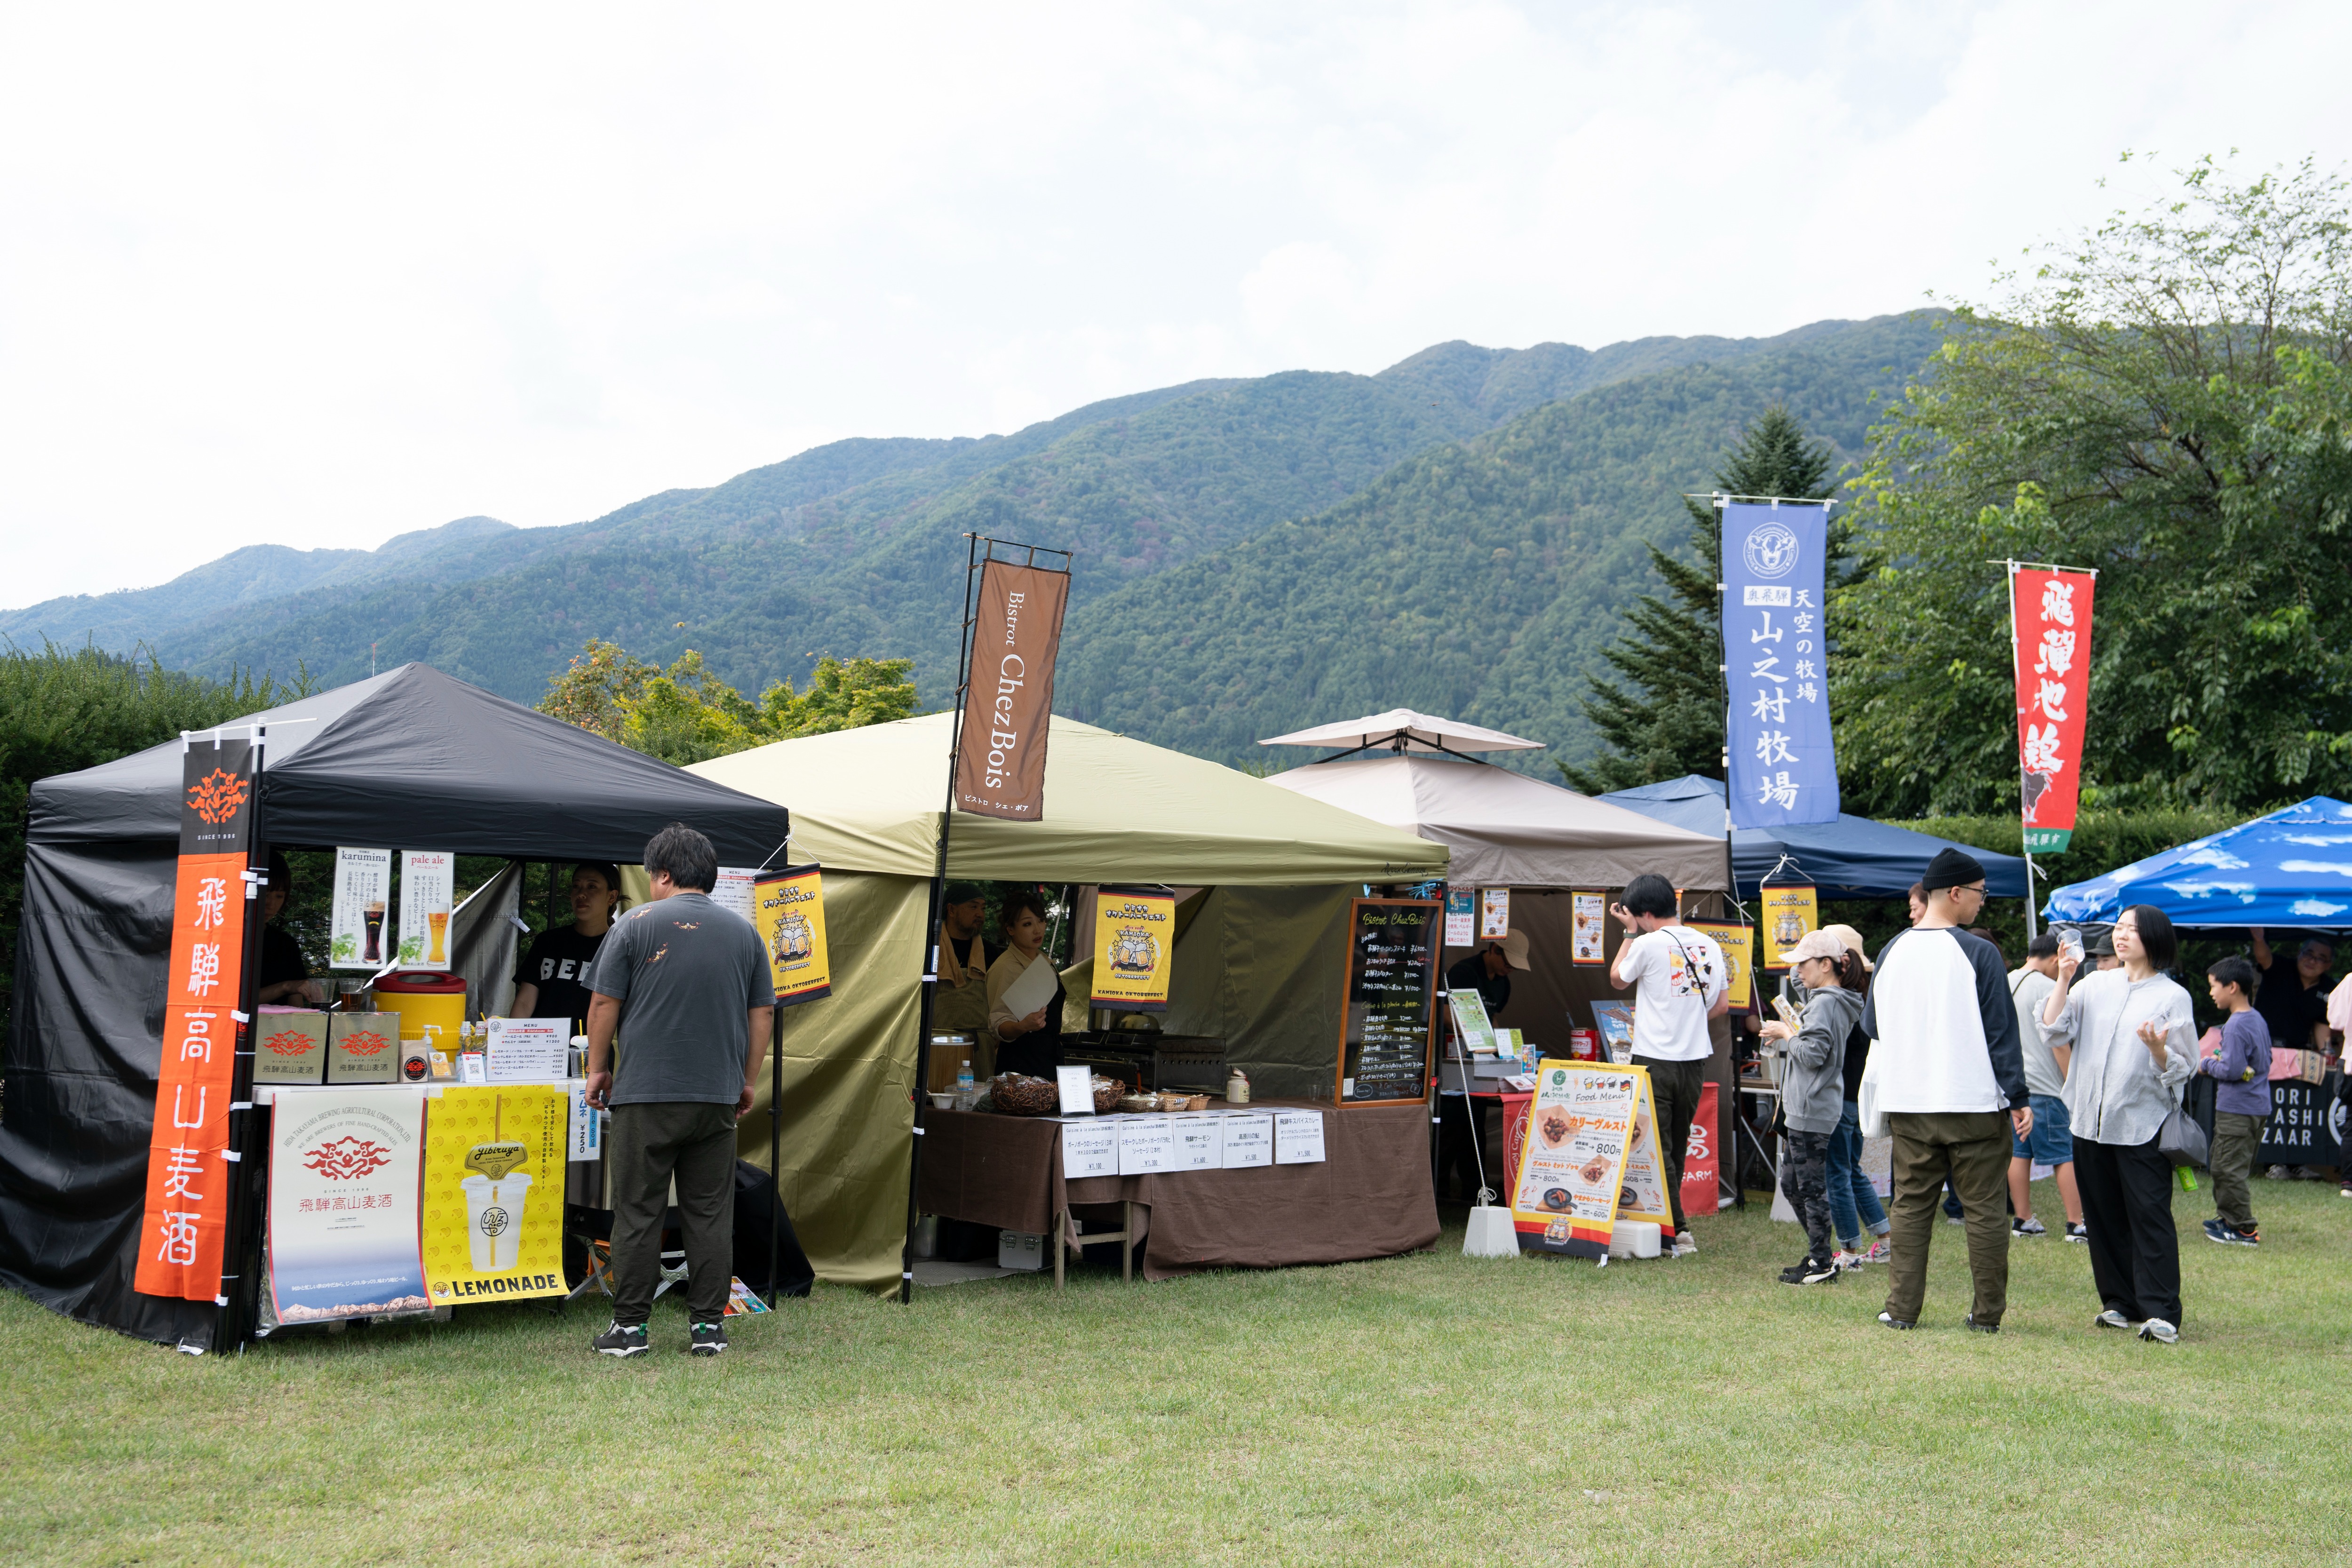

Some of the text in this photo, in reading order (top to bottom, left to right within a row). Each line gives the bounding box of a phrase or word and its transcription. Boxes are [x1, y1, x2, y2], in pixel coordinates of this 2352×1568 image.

[1794, 589, 1819, 703] 天空の牧場
[985, 590, 1025, 788] Bistrot Chez Bois
[1750, 611, 1800, 811] 山之村牧場
[965, 794, 1028, 812] ビストロ シェ・ボア
[342, 851, 386, 861] karumina
[411, 855, 444, 866] pale ale
[779, 886, 800, 897] カミオカ
[763, 891, 815, 908] オクトーバーフェスト
[1124, 903, 1148, 912] カミオカ
[778, 916, 804, 925] KAMIOKA
[1105, 910, 1167, 921] オクトーバーフェスト
[1363, 913, 1387, 925] Bistrot
[1391, 913, 1408, 925] Chez
[540, 958, 592, 981] BEE
[779, 962, 810, 972] OKTOBERFEST
[792, 977, 825, 988] OKTOBERFEST
[262, 1065, 314, 1074] 飛騨高山麦酒
[1576, 1093, 1597, 1101] Food
[1600, 1092, 1626, 1101] Menu
[2275, 1088, 2311, 1106] ORI
[1570, 1116, 1627, 1132] カリーヴルスト
[2274, 1108, 2323, 1126] ASHI
[283, 1135, 295, 1148] HIDA
[293, 1116, 318, 1137] TAKAYAMA
[318, 1108, 341, 1121] BREWING
[342, 1106, 376, 1117] AGRICULTURAL
[305, 1134, 315, 1143] ARE
[315, 1123, 336, 1137] BREWERS
[358, 1121, 389, 1138] HAND-CRAFTED
[388, 1136, 398, 1146] ALES
[2261, 1127, 2312, 1146] ZAAR
[475, 1146, 519, 1161] Jibiruya
[1597, 1143, 1621, 1155] 800円
[299, 1194, 393, 1213] 飛騨高山麦酒
[1594, 1210, 1607, 1219] 600円
[452, 1274, 558, 1297] LEMONADE
